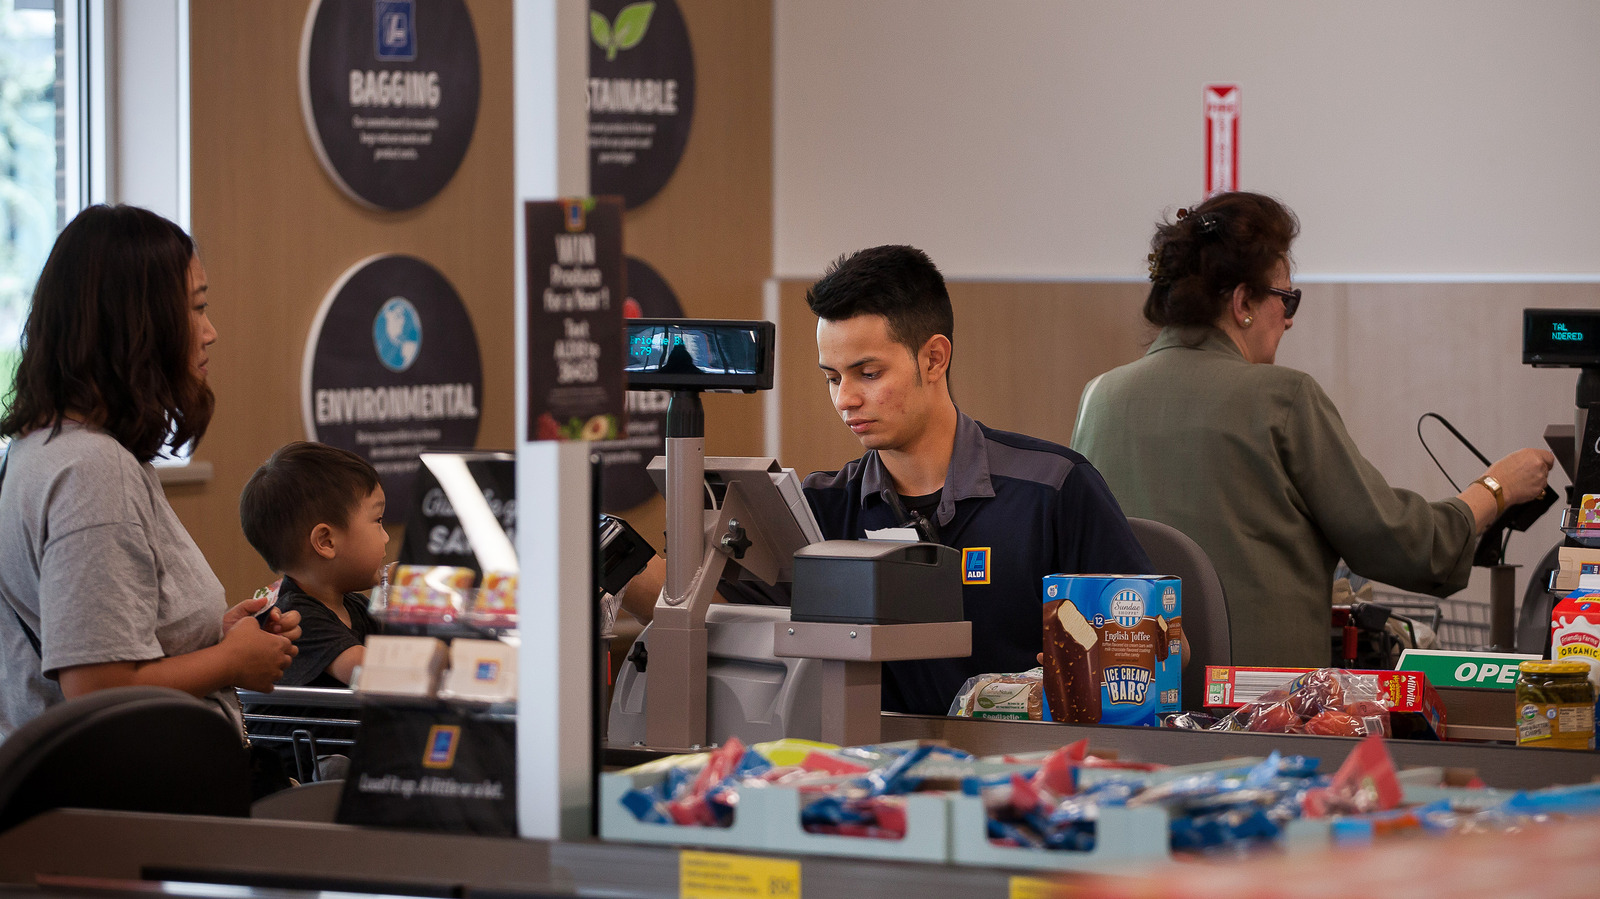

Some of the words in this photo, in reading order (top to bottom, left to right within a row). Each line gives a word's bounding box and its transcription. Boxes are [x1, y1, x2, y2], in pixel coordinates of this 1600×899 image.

[350, 70, 441, 108] BAGGING
[555, 233, 597, 265] WIN
[1552, 322, 1568, 331] TAL
[1551, 332, 1584, 341] NDERED
[315, 383, 478, 425] ENVIRONMENTAL
[967, 570, 985, 578] ALDI
[1113, 601, 1141, 611] Sundae
[1094, 616, 1104, 626] 12
[1104, 630, 1129, 642] English
[1130, 631, 1151, 643] Toffee
[1561, 634, 1582, 644] Friendly
[1582, 635, 1599, 645] Farms
[1561, 646, 1598, 658] ORGANIC
[1106, 668, 1120, 682] ICE
[1120, 667, 1150, 684] CREAM
[1454, 662, 1522, 684] OPE
[1109, 680, 1146, 702] BARS
[1406, 675, 1417, 707] Millville
